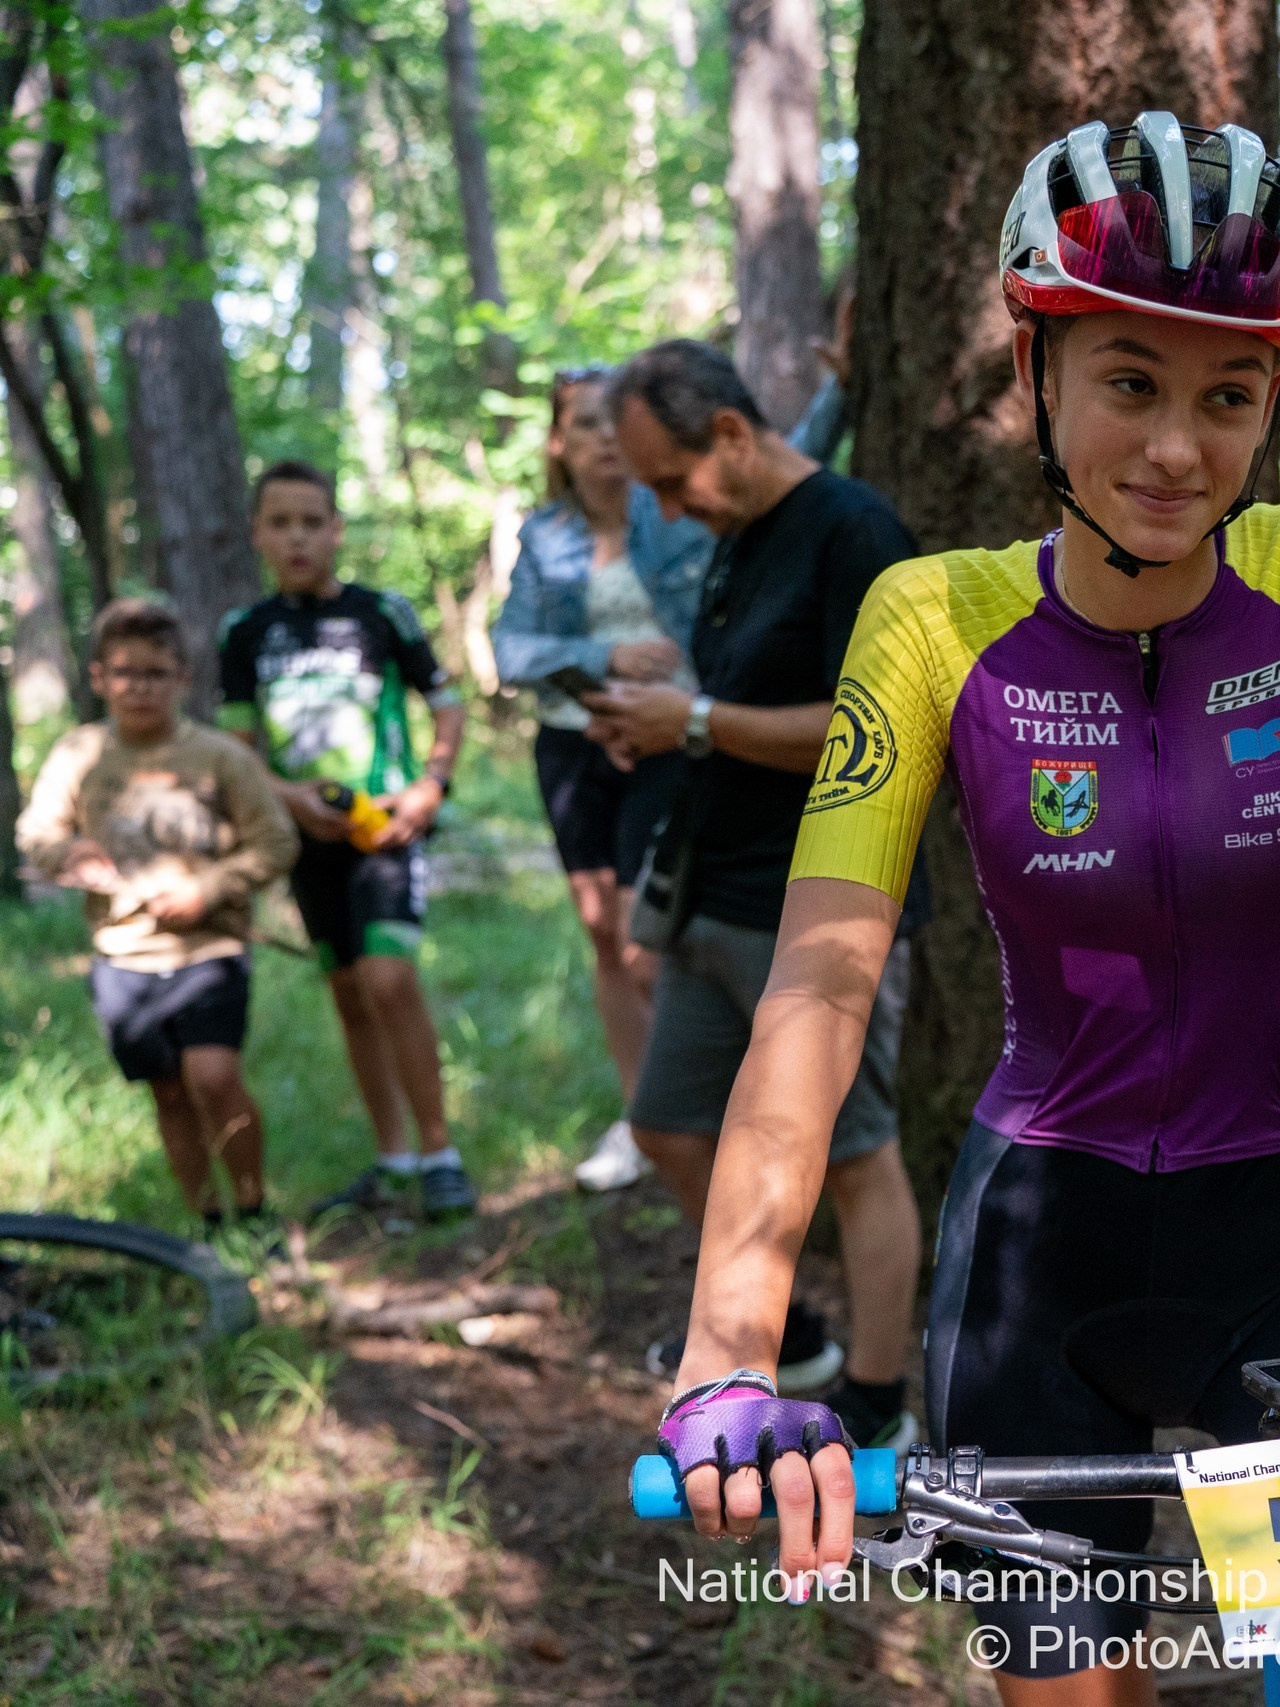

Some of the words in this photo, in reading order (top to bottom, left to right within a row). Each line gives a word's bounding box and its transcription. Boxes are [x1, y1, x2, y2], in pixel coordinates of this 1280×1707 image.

[1003, 685, 1123, 715] ОМЕГА
[1010, 717, 1120, 746] ТИЙМ
[1224, 824, 1273, 849] Bike
[1199, 1467, 1251, 1484] National
